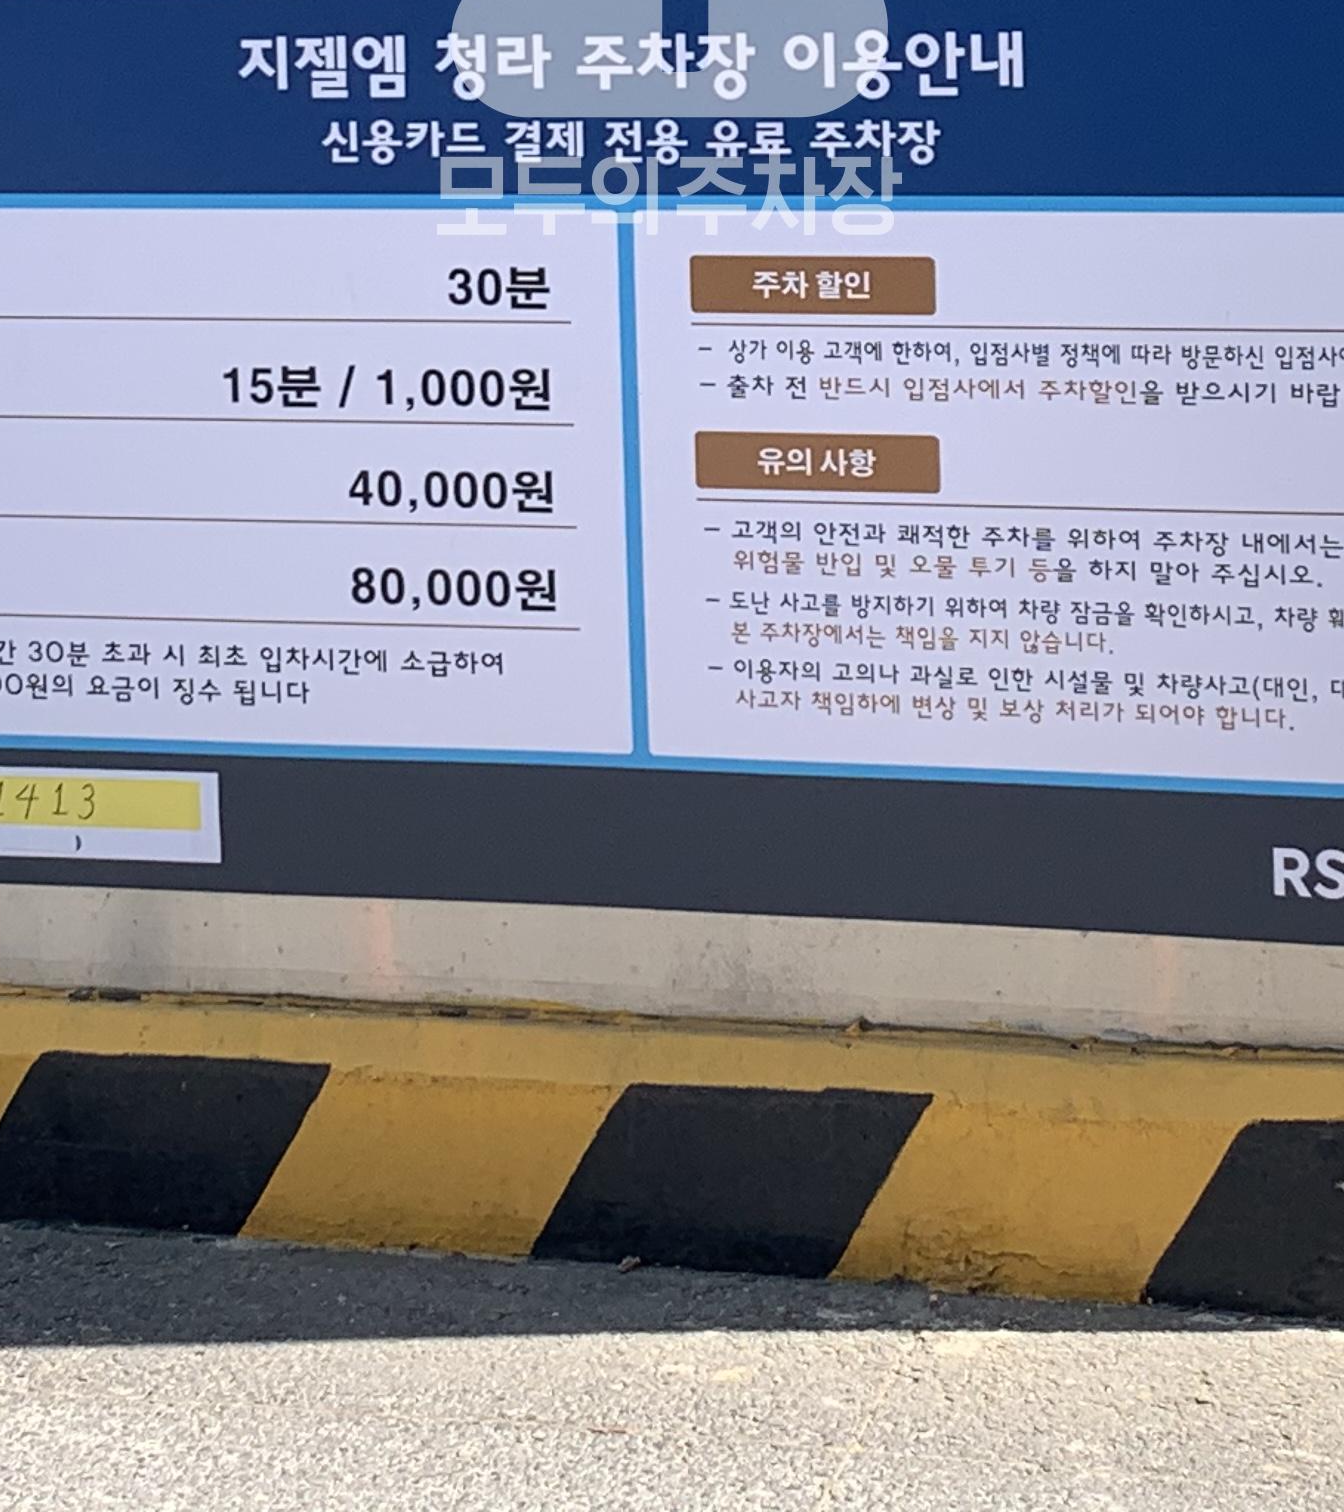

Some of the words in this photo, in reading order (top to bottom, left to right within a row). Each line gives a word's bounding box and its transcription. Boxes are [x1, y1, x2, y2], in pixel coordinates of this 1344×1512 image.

[239, 31, 409, 99] 지젤엠
[435, 31, 550, 101] 청라
[577, 31, 754, 99] 주차장
[785, 28, 1024, 99] 이용안내
[323, 121, 486, 164] 신용카드
[506, 121, 586, 164] 결제
[606, 121, 687, 164] 전용
[706, 121, 791, 164] 유료
[811, 120, 940, 164] 주차장
[449, 267, 550, 309] 30분
[753, 271, 808, 298] 주차
[816, 272, 870, 299] 할인
[729, 340, 767, 364] 상가
[777, 340, 814, 365] 이용
[824, 341, 882, 364] 고객에
[892, 342, 959, 366] 한하여,
[970, 343, 1049, 367] 입점사별
[1061, 344, 1120, 368] 정책에
[1132, 344, 1171, 365] 따라
[1182, 345, 1263, 370] 방문하신
[224, 366, 321, 407] 15분
[377, 369, 549, 411] 1,000원
[728, 374, 774, 398] 출차
[786, 376, 806, 399] 전
[820, 377, 889, 400] 반드시
[904, 378, 1024, 402] 입점사에서
[1039, 380, 1163, 405] 주차할인을
[1176, 382, 1275, 406] 받으시기
[758, 448, 811, 475] 유의
[820, 449, 876, 477] 사항
[349, 471, 552, 513] 40,000원
[732, 521, 800, 544] 고객의
[814, 523, 886, 546] 안전과
[898, 525, 970, 549] 쾌적한
[982, 527, 1055, 551] 주차를
[1068, 529, 1139, 550] 위하여
[1154, 531, 1229, 557] 주차장
[1242, 533, 1344, 559] 내에서는
[734, 550, 804, 575] 위험물
[816, 552, 860, 576] 반입
[876, 555, 895, 578] 및
[910, 555, 957, 579] 오물
[969, 557, 1014, 578] 투기
[1029, 558, 1076, 583] 등을
[1089, 560, 1135, 581] 하지
[1151, 562, 1199, 585] 말아
[1212, 564, 1322, 588] 주십시오.
[352, 568, 556, 611] 80,000원
[729, 592, 769, 615] 도난
[780, 593, 841, 617] 사고를
[852, 595, 933, 619] 방지하기
[945, 597, 1006, 618] 위하여
[1019, 599, 1060, 624] 차량
[1071, 601, 1134, 626] 잠금을
[1145, 603, 1262, 631] 확인하시고,
[1275, 607, 1317, 632] 차량
[732, 622, 751, 644] 본
[760, 622, 885, 649] 주차장에서는
[896, 625, 958, 651] 책임을
[970, 629, 1008, 649] 지지
[1021, 630, 1113, 654] 않습니다.
[29, 641, 89, 667] 30분
[102, 642, 150, 665] 초과
[163, 644, 184, 666] 시
[199, 645, 247, 667] 최초
[260, 647, 386, 675] 입차시간에
[401, 651, 503, 677] 소급하여
[87, 676, 158, 702] 요금이
[174, 679, 221, 705] 징수
[234, 680, 309, 706] 됩니다
[734, 659, 820, 684] 이용자의
[833, 663, 899, 684] 고의나
[911, 666, 978, 689] 과실로
[989, 668, 1033, 692] 인한
[1045, 670, 1112, 695] 시설물
[1125, 673, 1144, 696] 및
[1157, 673, 1317, 703] 차량사고(대인,
[736, 690, 801, 711] 사고자
[812, 691, 899, 716] 책임하에
[913, 696, 955, 720] 변상
[968, 697, 987, 721] 및
[1000, 699, 1044, 724] 보상
[1056, 701, 1124, 722] 처리가
[1136, 704, 1204, 726] 되어야
[1216, 706, 1294, 731] 합니다.
